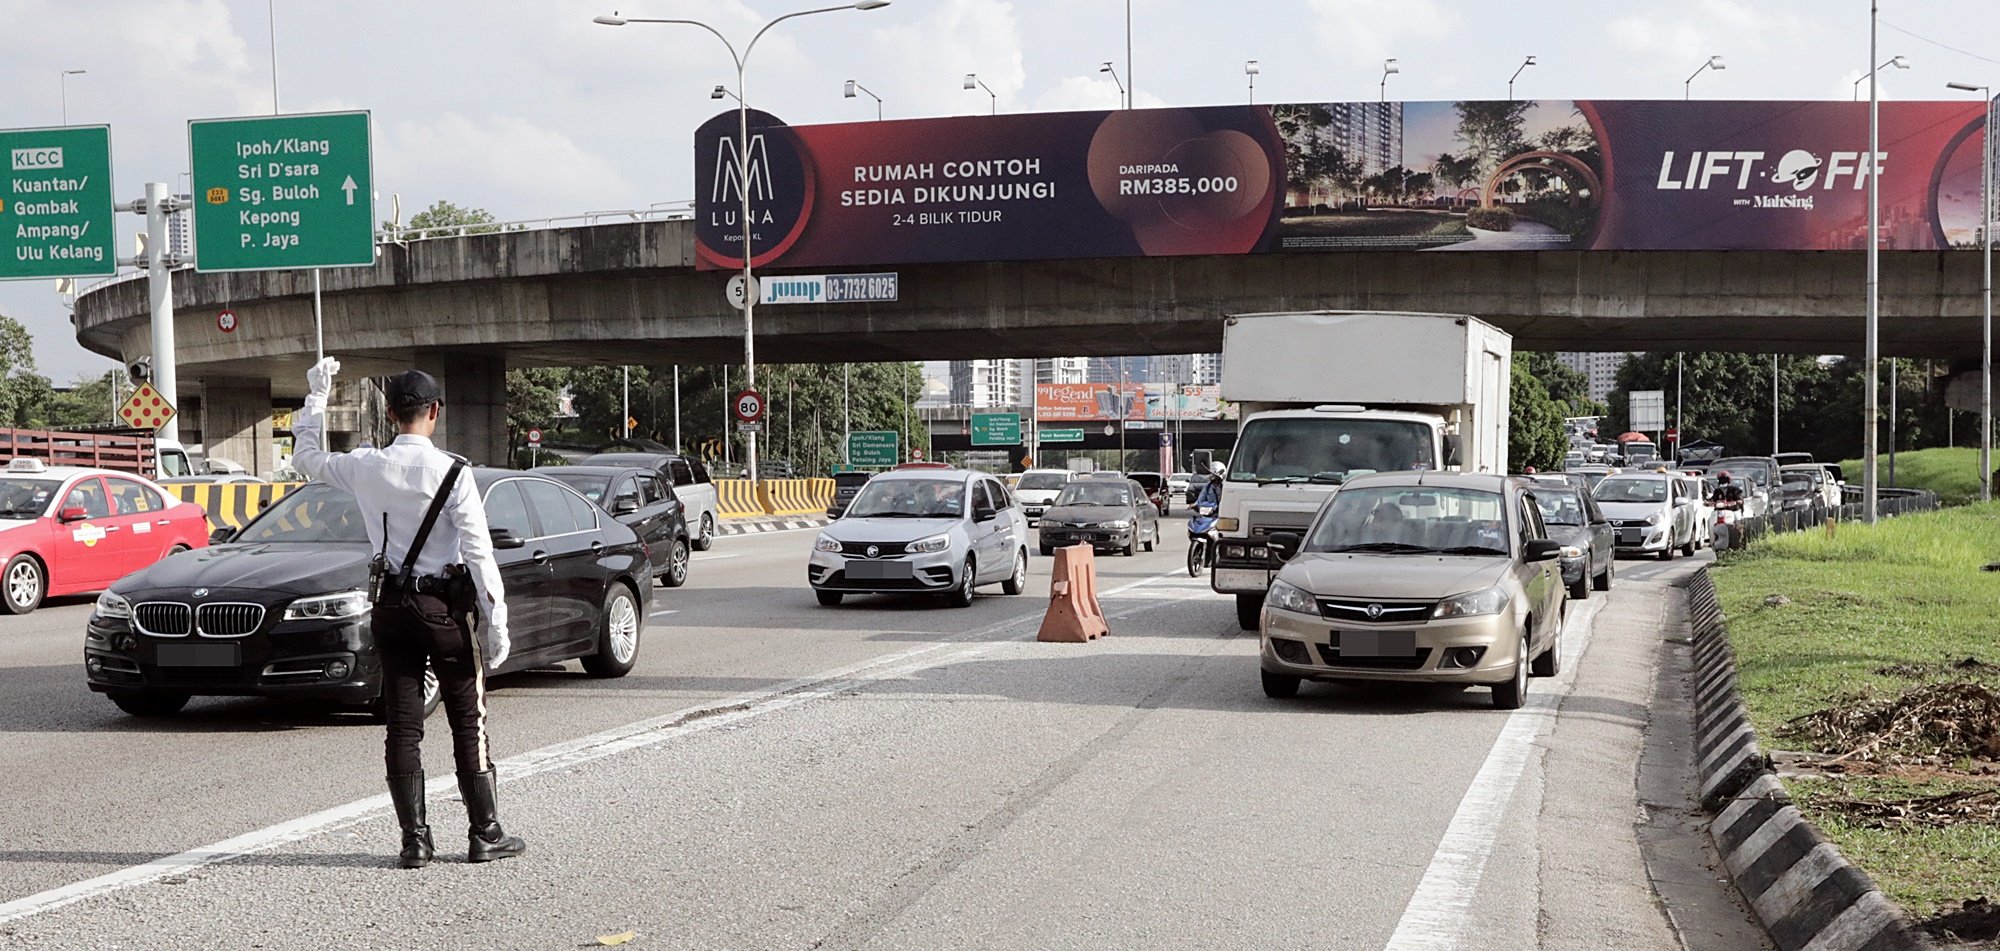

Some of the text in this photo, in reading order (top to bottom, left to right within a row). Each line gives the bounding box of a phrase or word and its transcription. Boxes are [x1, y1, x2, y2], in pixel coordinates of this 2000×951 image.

[237, 138, 329, 159] Ipoh/Klang
[15, 151, 59, 166] KLCC
[239, 163, 319, 179] Sri D'sara
[854, 158, 1040, 182] RUMAH CONTOH
[1119, 163, 1179, 175] DARIPADA
[13, 176, 88, 193] Kuantan/
[1120, 176, 1238, 195] RM385,000
[240, 184, 319, 205] Sg. Buloh
[841, 182, 1055, 206] SEDIA DIKUNJUNGI
[1733, 194, 1814, 210] WITH MahSing
[14, 199, 79, 216] Gombak
[240, 210, 300, 227] Kepong
[893, 210, 1002, 226] 2-4 BILIK TIDUR
[16, 221, 90, 240] Ampang/
[752, 233, 762, 241] KL
[241, 232, 299, 250] P. Jaya
[16, 244, 103, 261] Ulu Kelang
[767, 277, 895, 303] jump 03-7732 6025
[741, 402, 757, 413] 80
